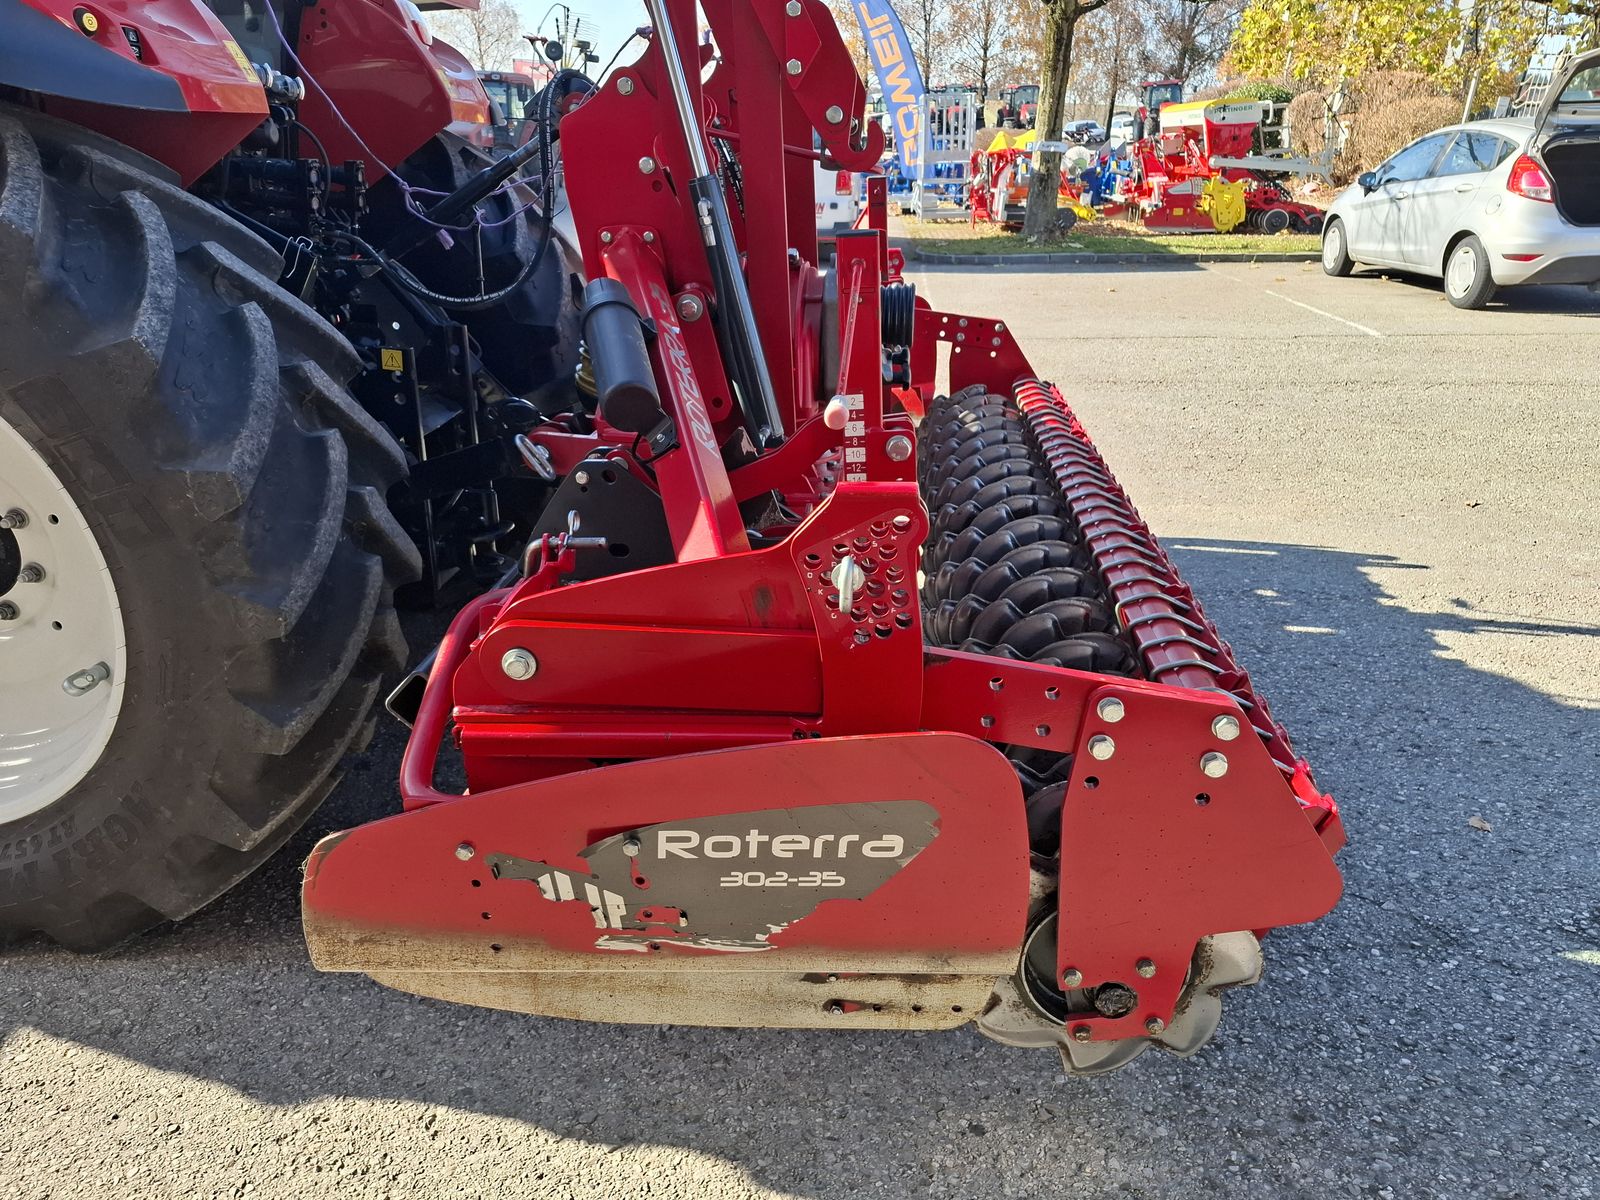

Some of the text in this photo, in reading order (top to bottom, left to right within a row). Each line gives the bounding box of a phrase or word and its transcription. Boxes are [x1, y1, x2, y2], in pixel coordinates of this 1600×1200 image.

[1214, 105, 1253, 114] PTINGER
[659, 319, 720, 458] ROTERRA
[850, 397, 856, 406] 2
[852, 424, 857, 432] 6
[852, 437, 858, 446] 8
[851, 450, 861, 459] 10
[852, 463, 862, 472] 12
[657, 829, 904, 859] Roterra
[720, 871, 846, 887] 302-35
